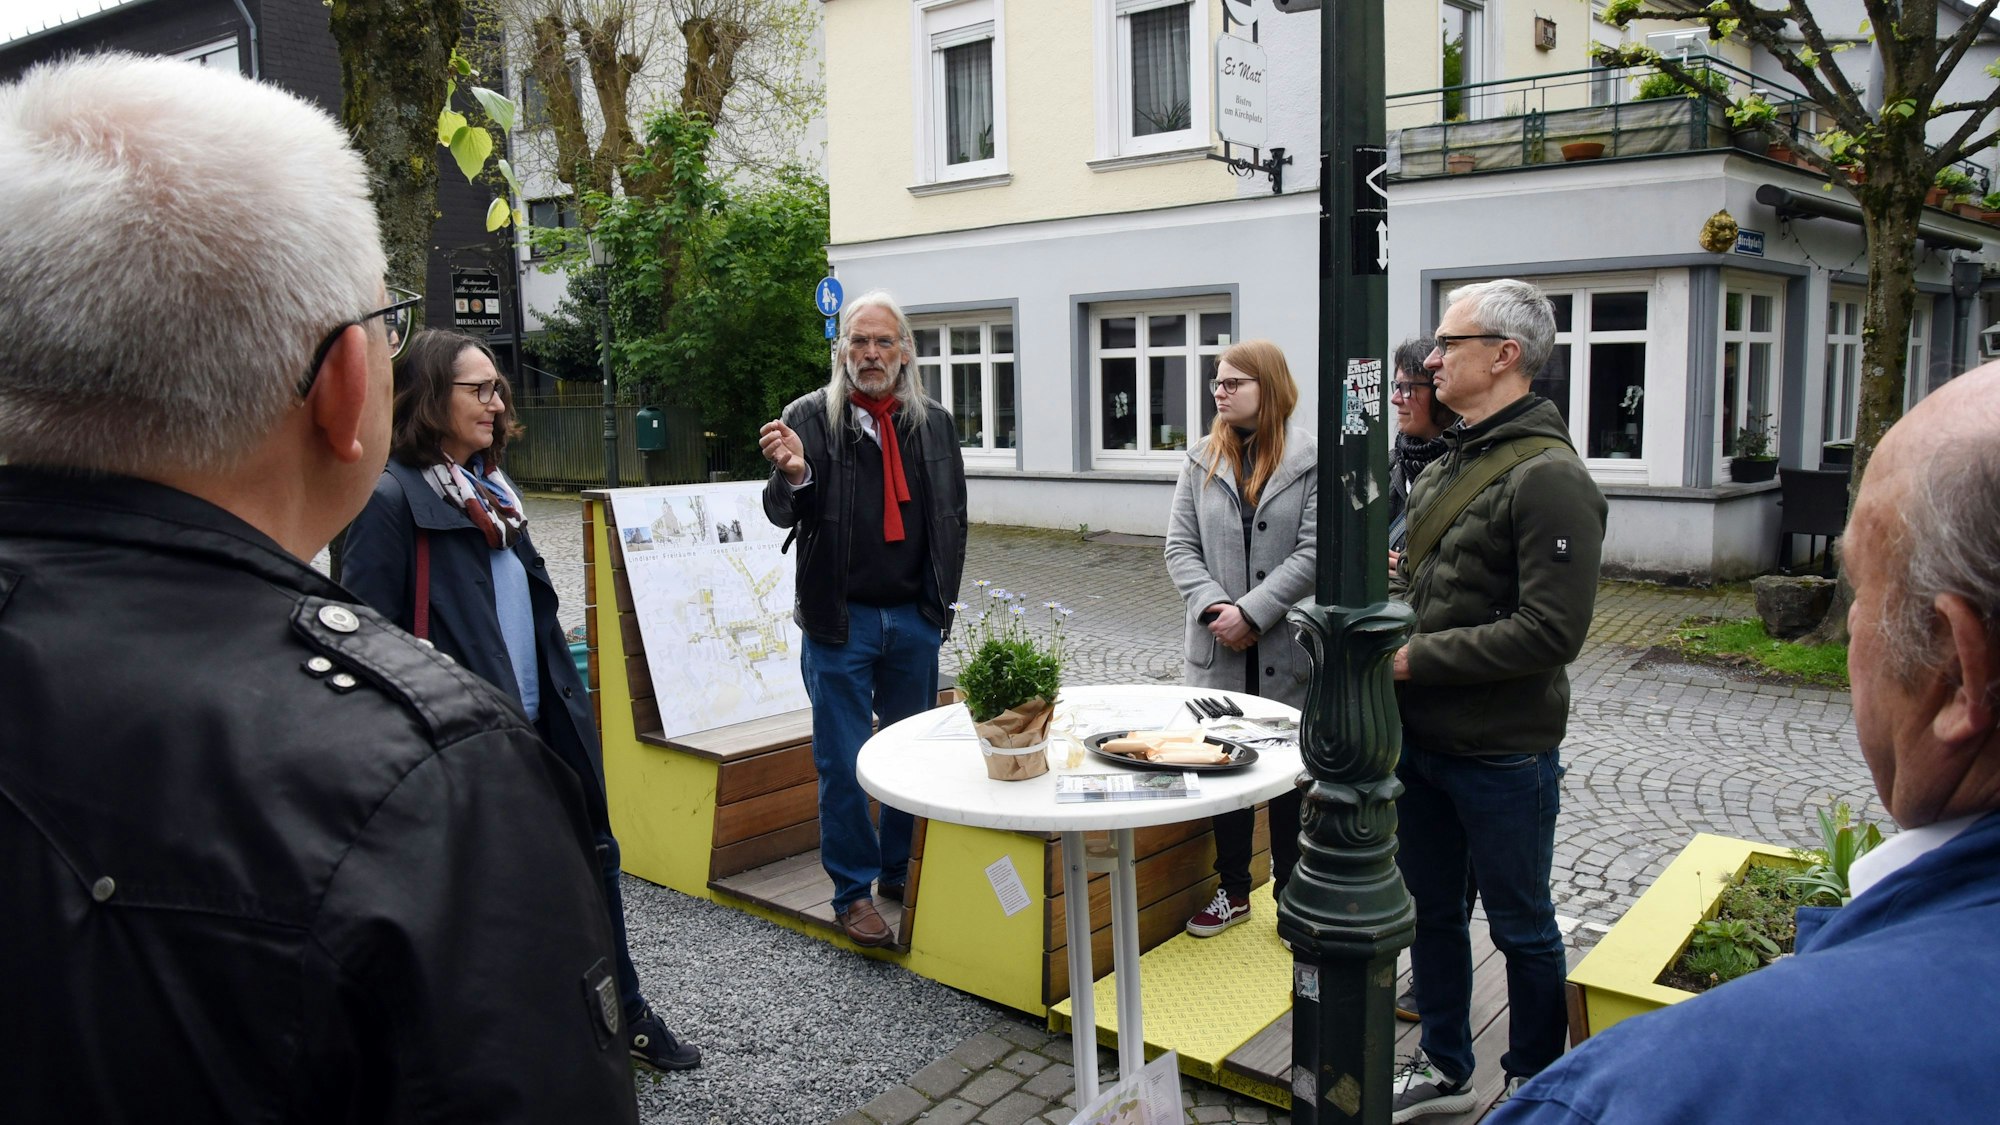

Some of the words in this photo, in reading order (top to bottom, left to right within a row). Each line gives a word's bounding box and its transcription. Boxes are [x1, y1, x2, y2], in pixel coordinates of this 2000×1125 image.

[1235, 95, 1252, 107] Bistro
[1224, 107, 1234, 116] am
[1235, 108, 1262, 123] Kirchplatz
[1348, 360, 1381, 374] ERSTER
[1347, 370, 1381, 390] FUSS
